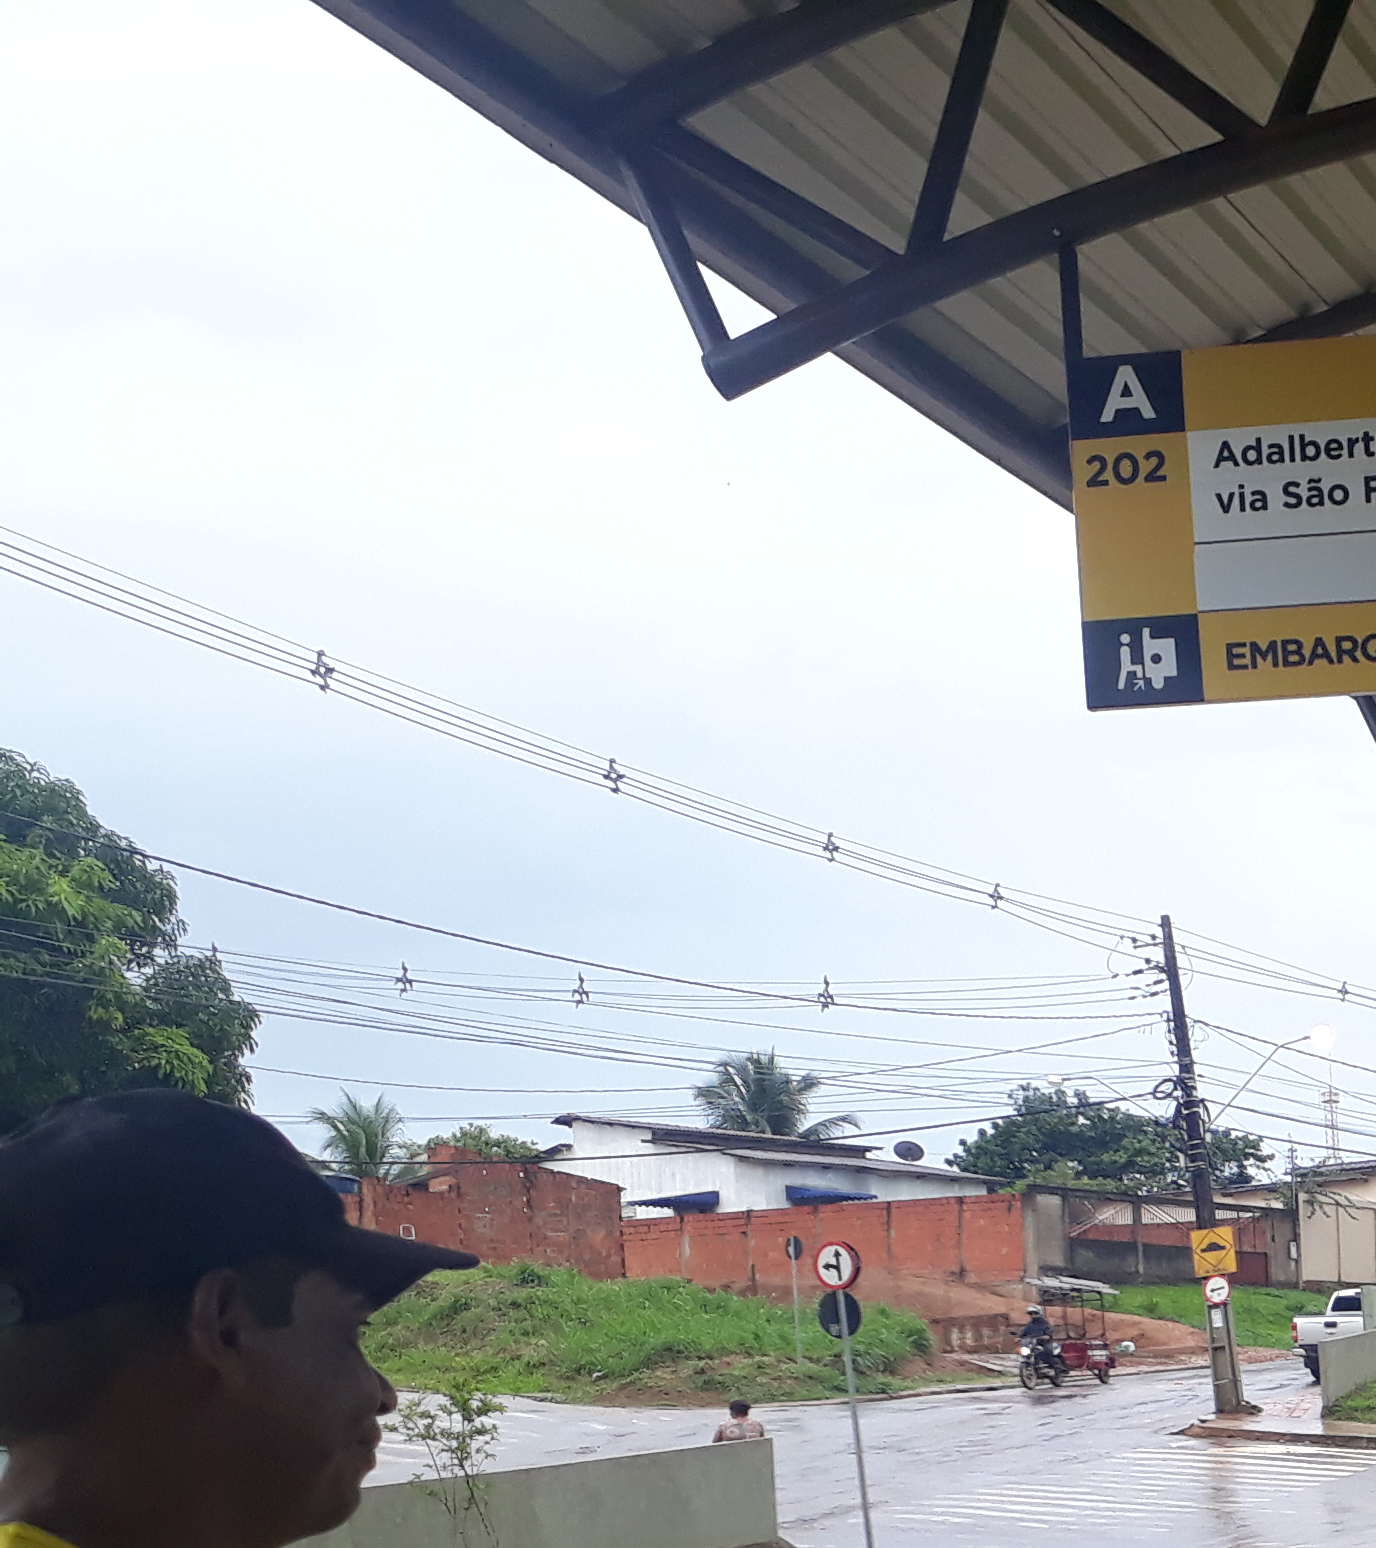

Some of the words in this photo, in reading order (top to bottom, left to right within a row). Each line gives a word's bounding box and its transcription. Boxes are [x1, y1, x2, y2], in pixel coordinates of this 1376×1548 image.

[1100, 365, 1157, 423] A
[1085, 450, 1168, 488] 202
[1215, 485, 1269, 515] via
[1281, 477, 1350, 510] São
